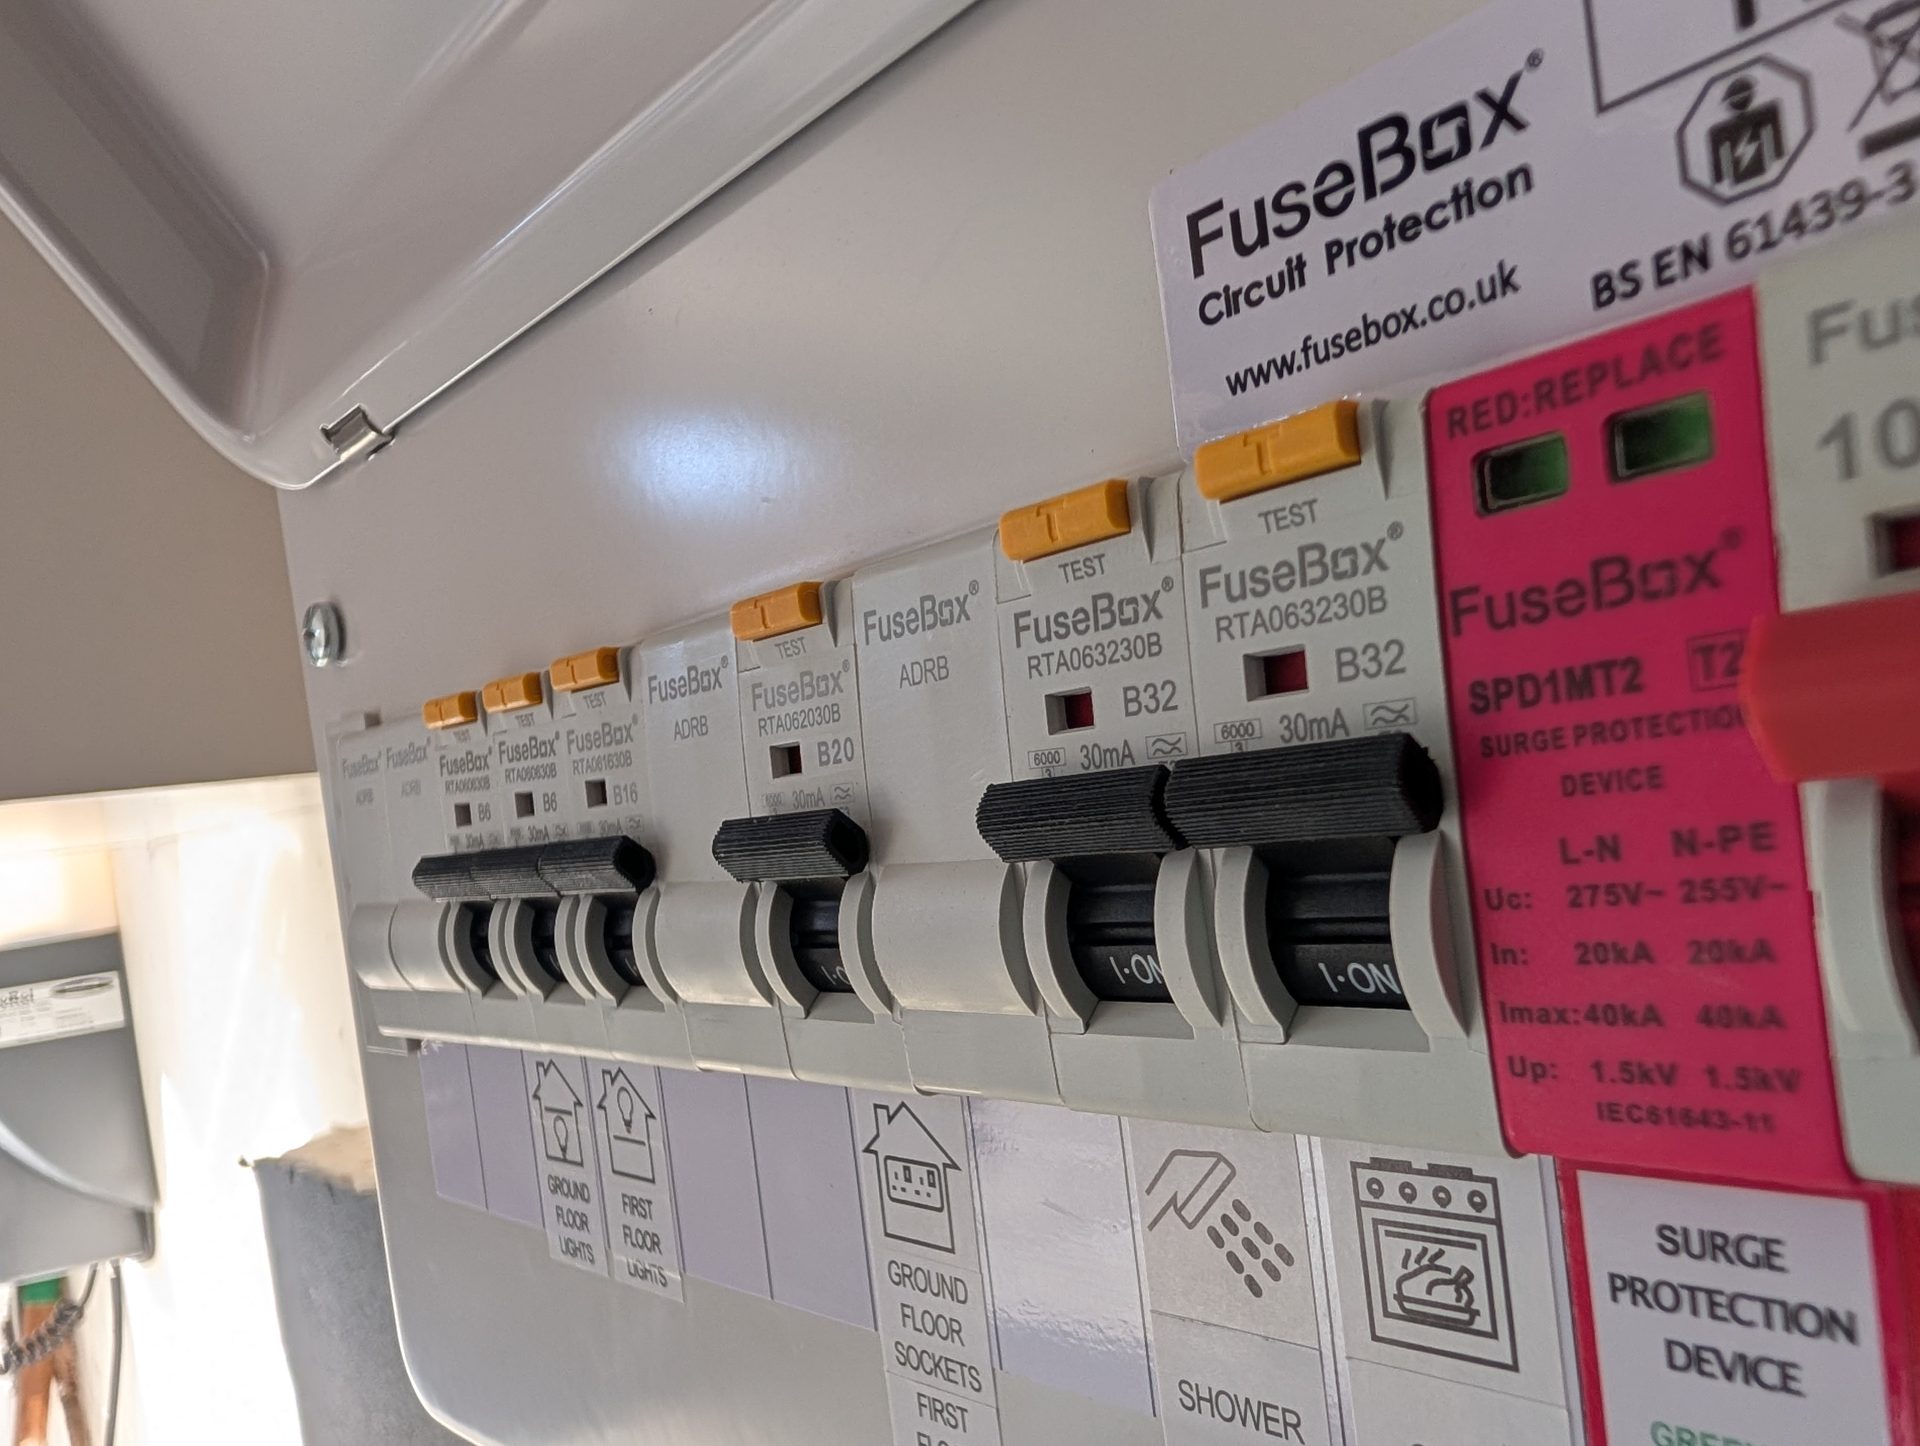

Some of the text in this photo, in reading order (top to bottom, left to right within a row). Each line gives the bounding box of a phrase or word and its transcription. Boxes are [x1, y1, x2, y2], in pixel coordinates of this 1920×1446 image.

[1198, 163, 1534, 327] Circuit Protection
[1590, 159, 1919, 311] BS EN 61439-3
[1225, 261, 1521, 397] www.fusebox.co.uk
[1806, 292, 1920, 367] Fu
[1447, 321, 1726, 440] RED:REPLACE
[1258, 499, 1320, 535] TEST
[1058, 553, 1106, 584] TEST
[1215, 585, 1388, 643] RTA063230B
[774, 636, 808, 660] TEST
[1027, 632, 1163, 680] RTA063230B
[1334, 638, 1407, 684] B32
[899, 655, 951, 690] ADRB
[1467, 639, 1746, 716] SPD1MT2 T2
[582, 691, 608, 710] TEST
[1122, 680, 1179, 718] B32
[673, 715, 710, 741] ADRB
[758, 702, 842, 738] RTA062030B
[1220, 706, 1351, 744] 6000 30mA
[816, 735, 856, 768] B20
[1033, 738, 1136, 771] 6000 30mA
[1479, 726, 1567, 760] SURGE
[612, 782, 639, 806] B16
[792, 786, 827, 811] 30mA
[1560, 765, 1666, 799] DEVICE
[1558, 821, 1777, 866] L-N N-PE
[1574, 940, 1656, 966] 20kA
[1686, 937, 1776, 966] 20kA
[1696, 1003, 1787, 1031] 40kA
[1507, 1055, 1802, 1094] Up: 1.5kV 1.5kV
[547, 1173, 591, 1204] GROUND
[621, 1192, 653, 1222] FIRST
[555, 1204, 590, 1234] FLOOR
[558, 1234, 596, 1266] LIGHTS
[622, 1223, 664, 1256] FLOOR
[1656, 1222, 1790, 1275] SURGE
[626, 1258, 669, 1289] LIGHTS
[887, 1258, 969, 1306] GROUND
[900, 1302, 966, 1348] FLOOR
[1607, 1270, 1861, 1347] PROTECTION
[893, 1338, 983, 1394] SOCKETS
[1663, 1337, 1807, 1399] DEVICE
[916, 1391, 969, 1434] FIRST
[1177, 1377, 1306, 1446] SHOWER
